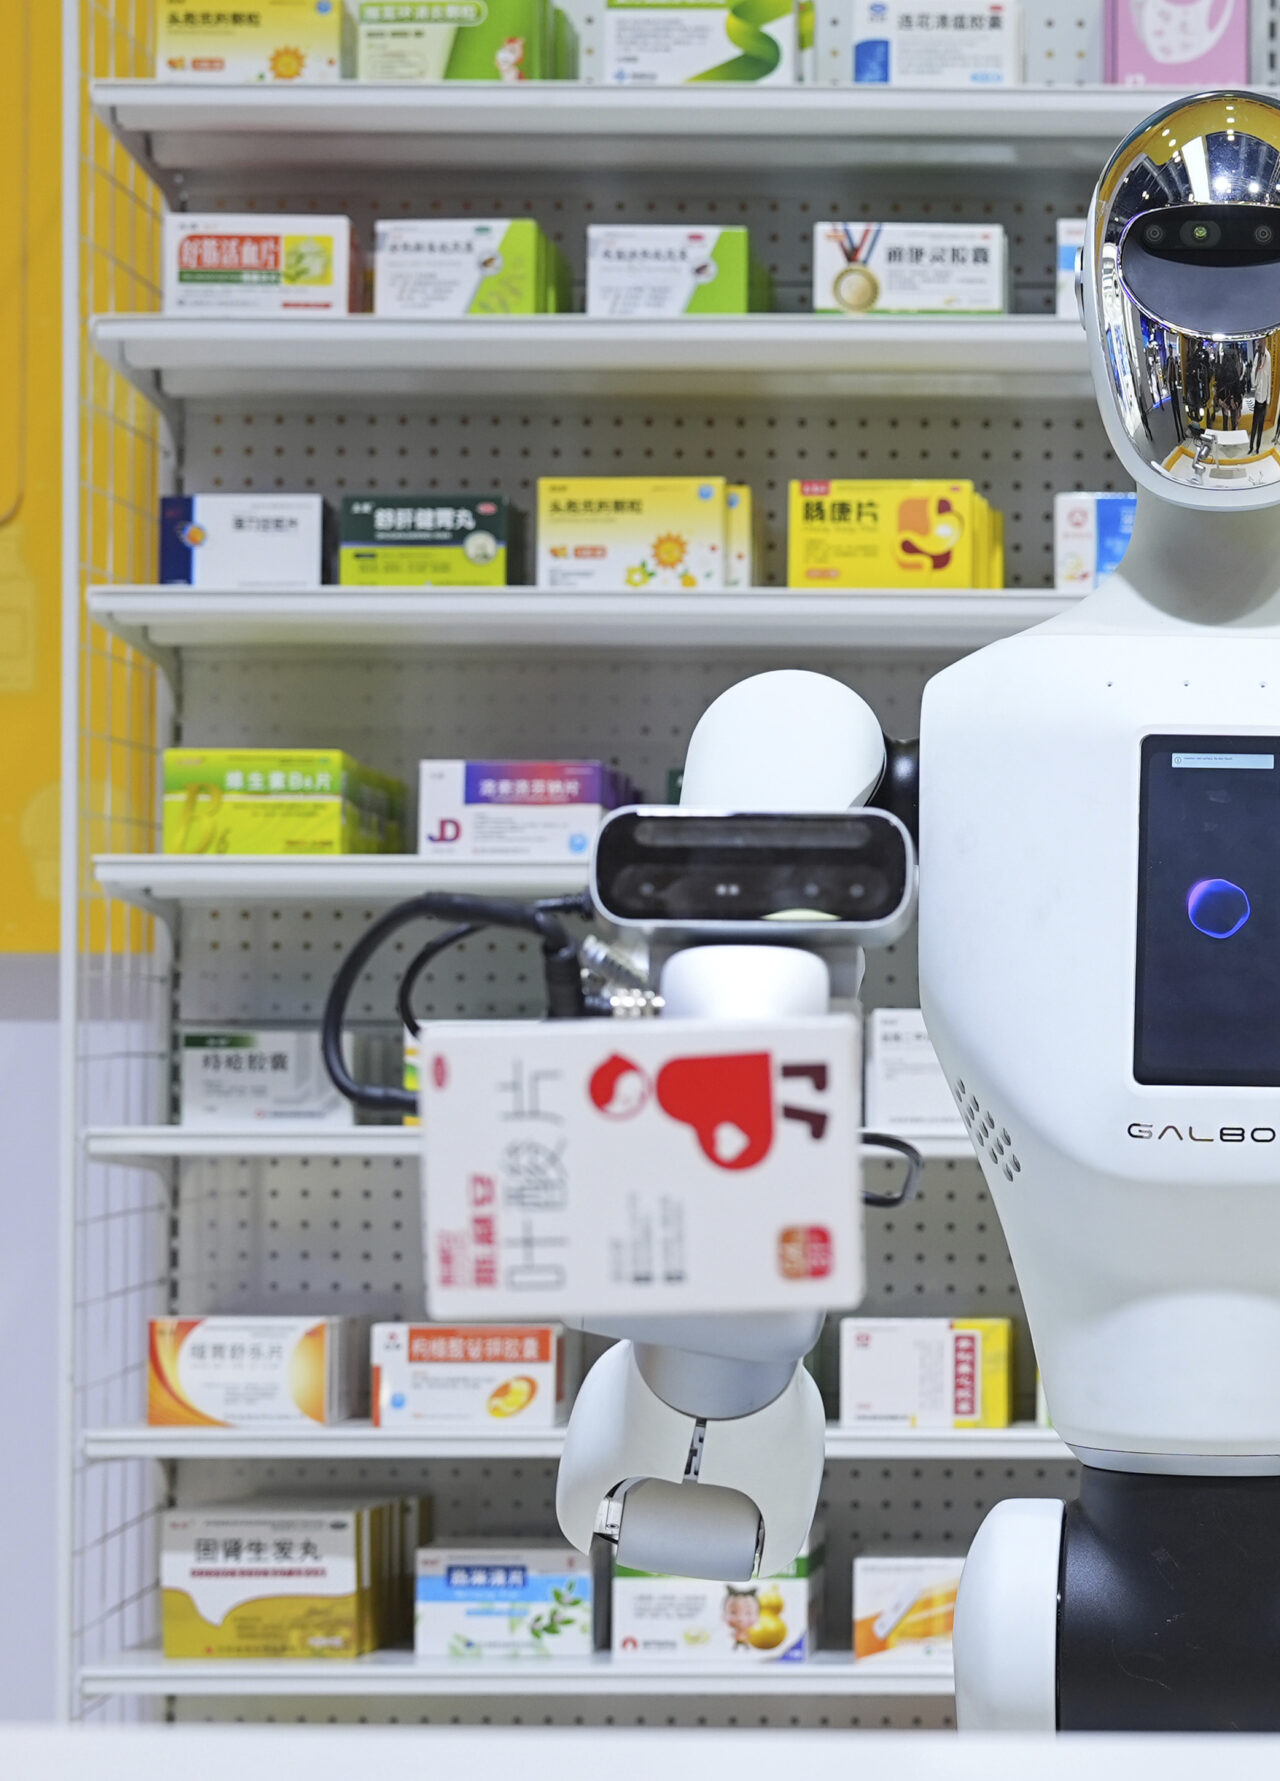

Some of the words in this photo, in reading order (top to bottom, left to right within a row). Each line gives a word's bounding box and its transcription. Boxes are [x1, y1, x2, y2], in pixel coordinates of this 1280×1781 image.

[374, 508, 476, 530] 舒肝健胃丸
[803, 501, 879, 522] 肠康片
[497, 1058, 568, 1291] 叶酸片
[195, 1537, 322, 1563] 固肾生发丸
